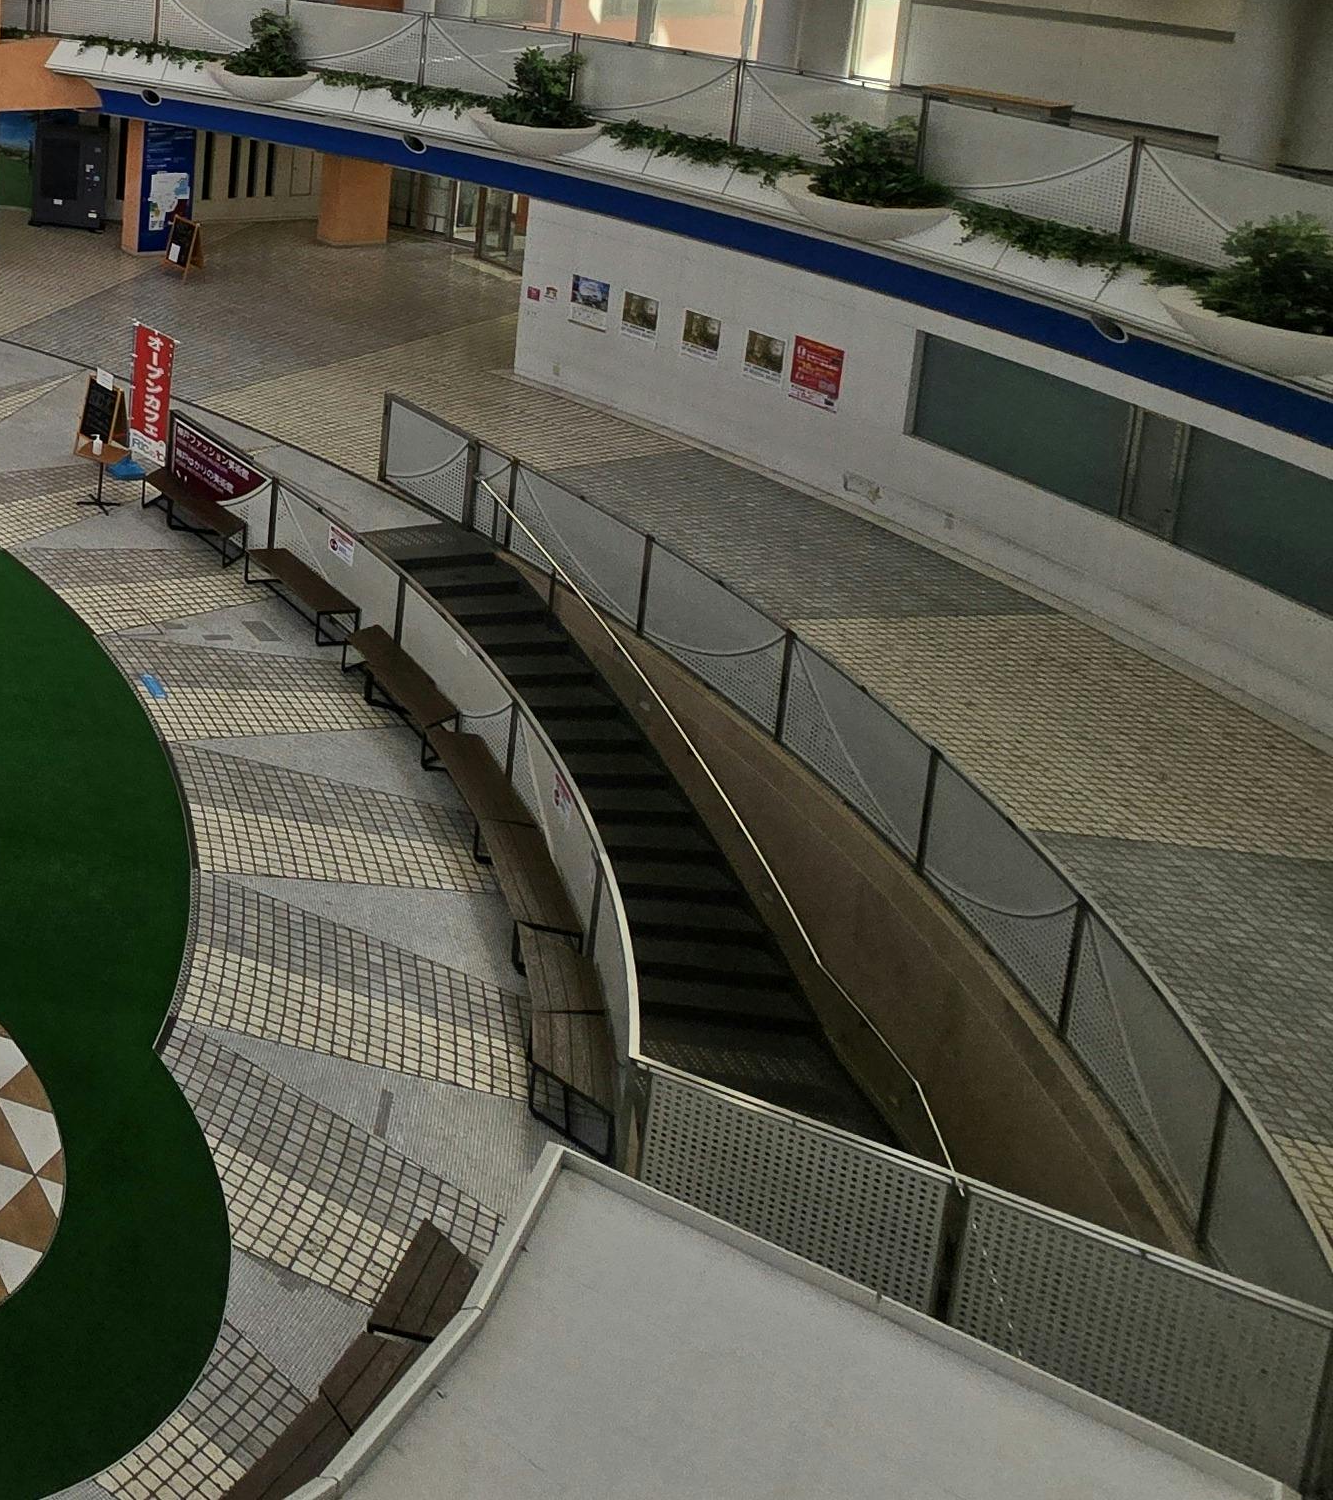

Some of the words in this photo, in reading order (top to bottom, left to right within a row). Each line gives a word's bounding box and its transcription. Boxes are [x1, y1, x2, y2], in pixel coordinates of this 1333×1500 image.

[143, 335, 165, 438] オープンカフェ
